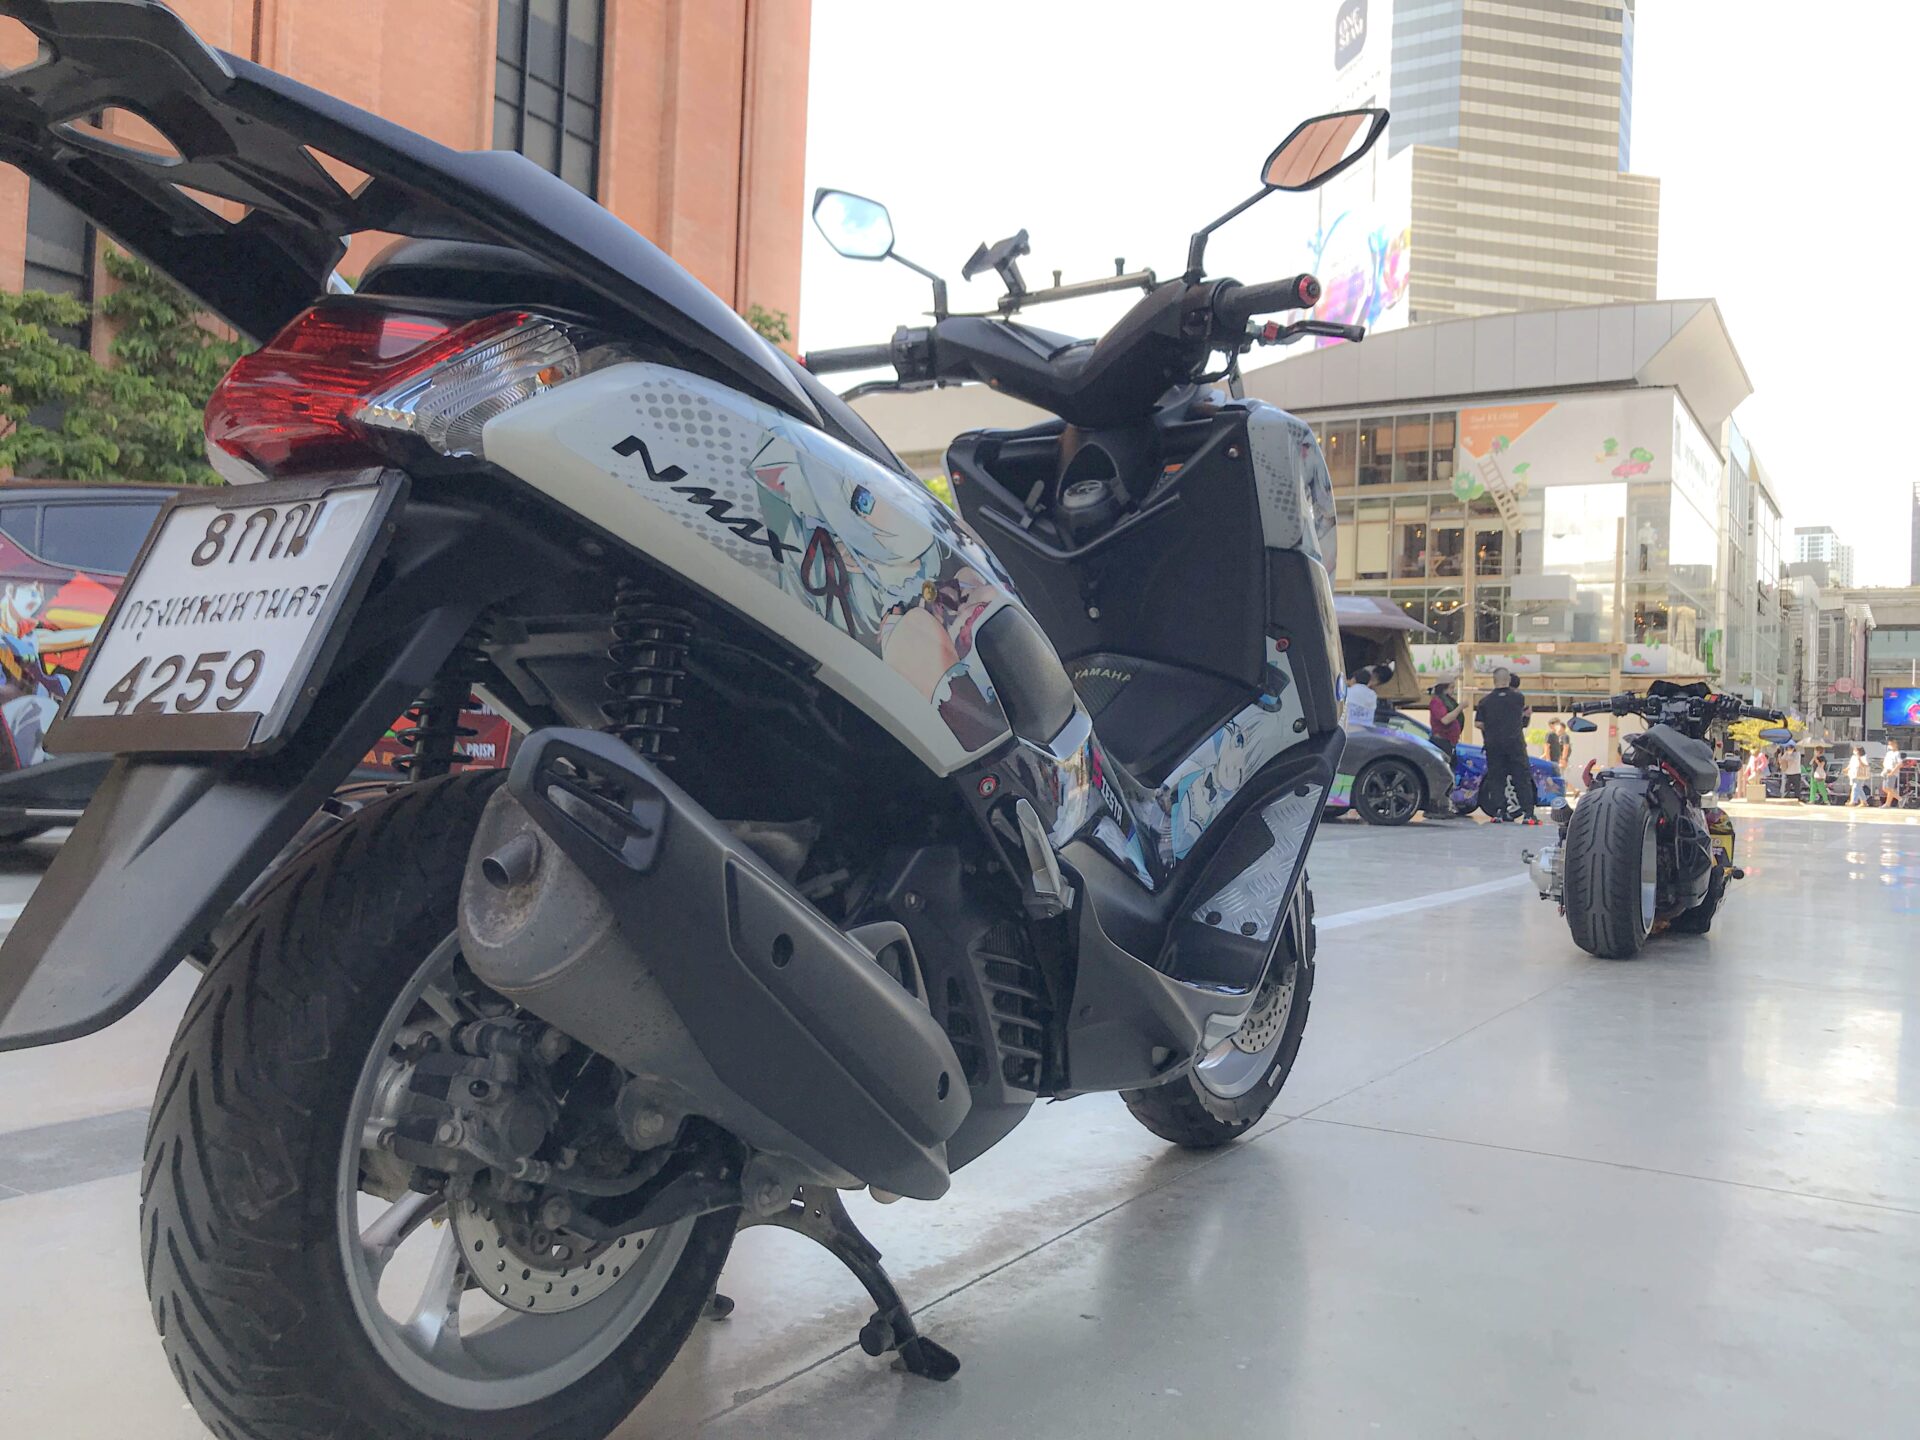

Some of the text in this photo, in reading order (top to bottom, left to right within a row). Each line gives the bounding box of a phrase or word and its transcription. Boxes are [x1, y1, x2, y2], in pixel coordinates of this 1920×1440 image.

[122, 585, 329, 641] กรุงเทพมหานคร
[103, 649, 266, 716] 4259
[1074, 667, 1132, 681] YAMAHA
[466, 743, 496, 758] PRISM
